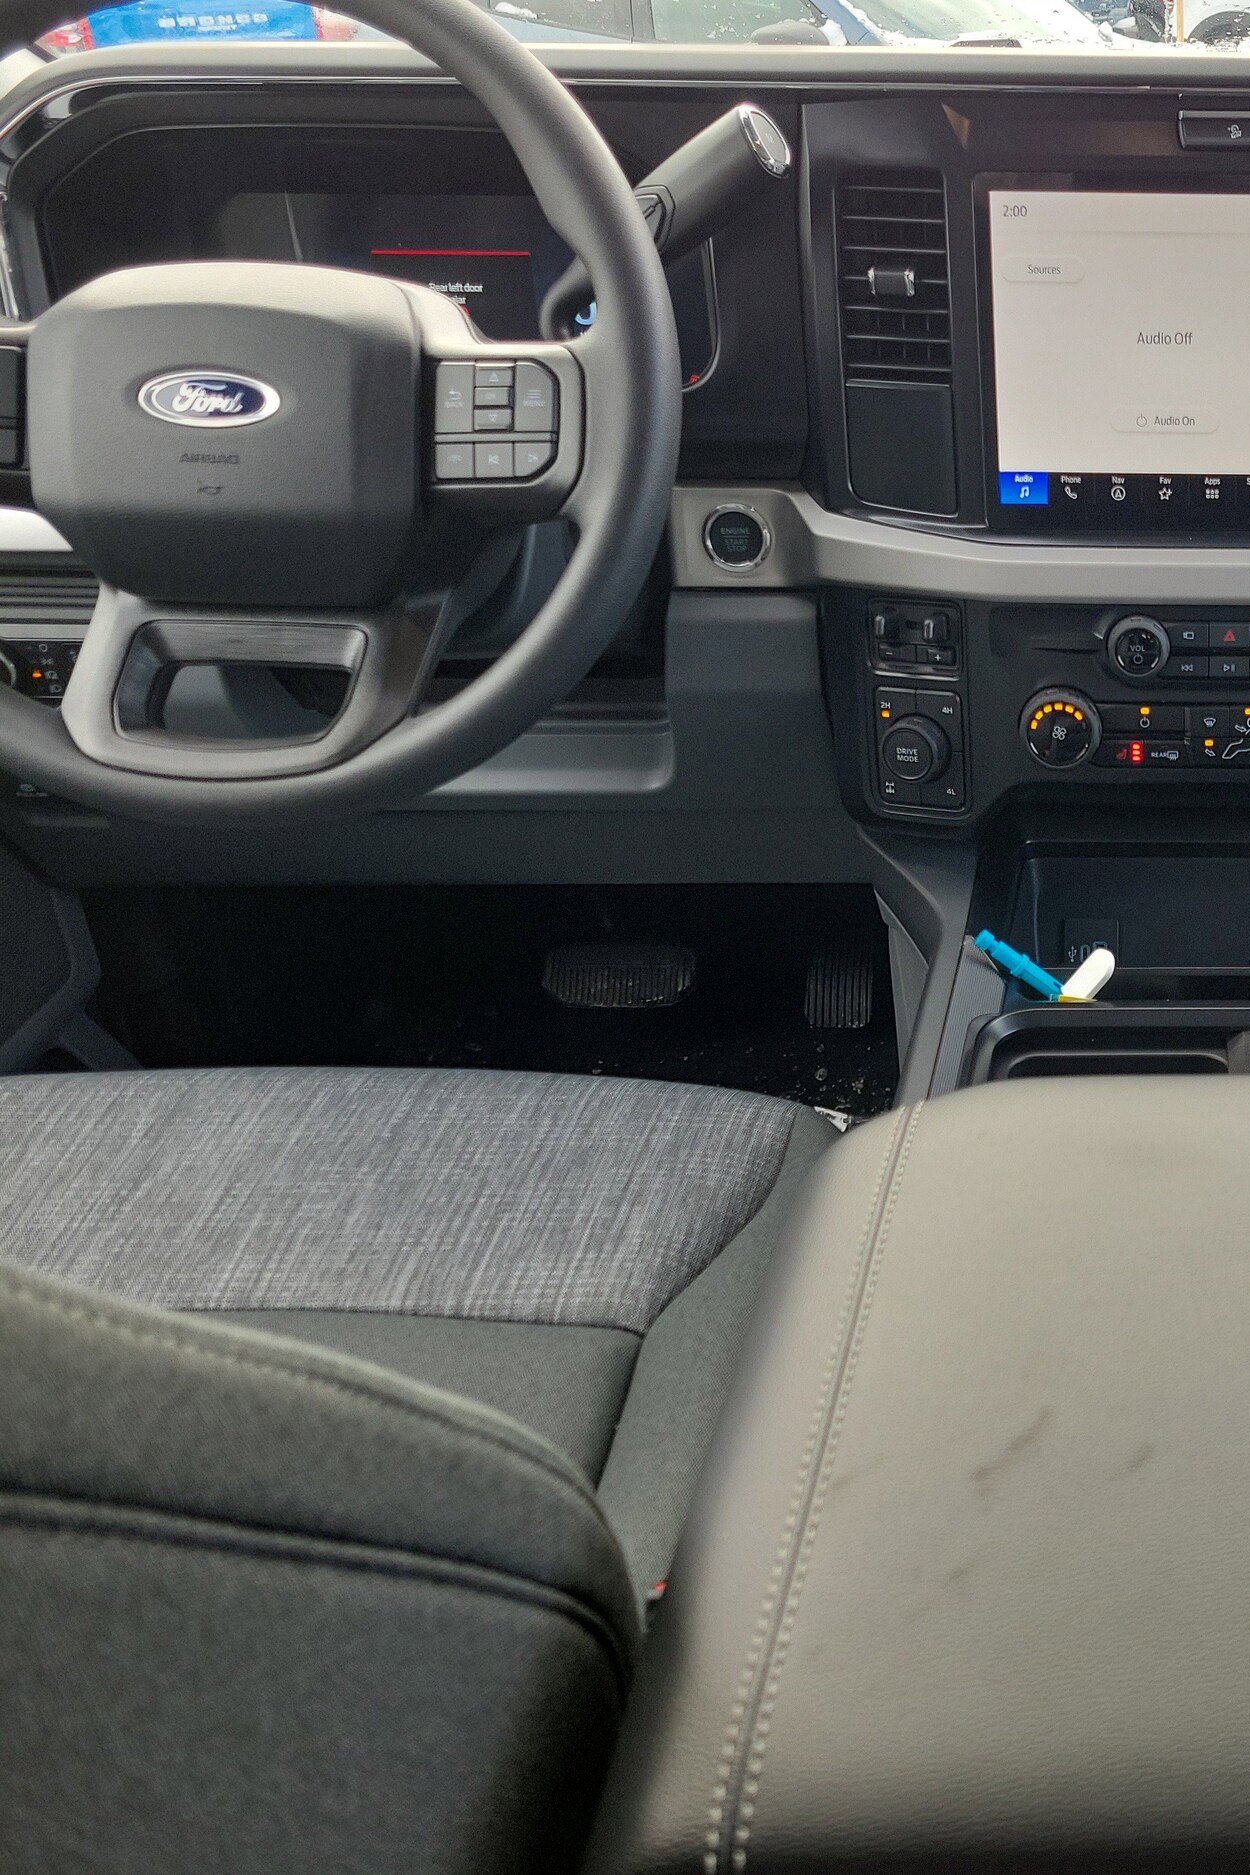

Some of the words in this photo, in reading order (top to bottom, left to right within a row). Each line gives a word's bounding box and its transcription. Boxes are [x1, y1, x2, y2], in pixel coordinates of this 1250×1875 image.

[1002, 204, 1028, 217] 2:00
[1027, 264, 1062, 275] Sources
[448, 282, 464, 292] left
[464, 282, 483, 292] door
[1136, 331, 1172, 345] Audio
[1174, 332, 1193, 345] Off
[172, 381, 245, 413] Ford
[1153, 415, 1181, 426] Audio
[1181, 415, 1196, 426] On
[1014, 474, 1034, 484] Audio
[1060, 475, 1082, 484] Phone
[1112, 476, 1125, 484] Nav
[1159, 476, 1172, 485] Fav
[1204, 476, 1221, 486] Apps
[1130, 644, 1146, 652] VOL
[880, 701, 891, 710] 2H
[941, 706, 953, 715] 4H
[896, 747, 919, 756] DRIVE
[896, 755, 920, 763] MODE
[946, 788, 957, 796] 4L
